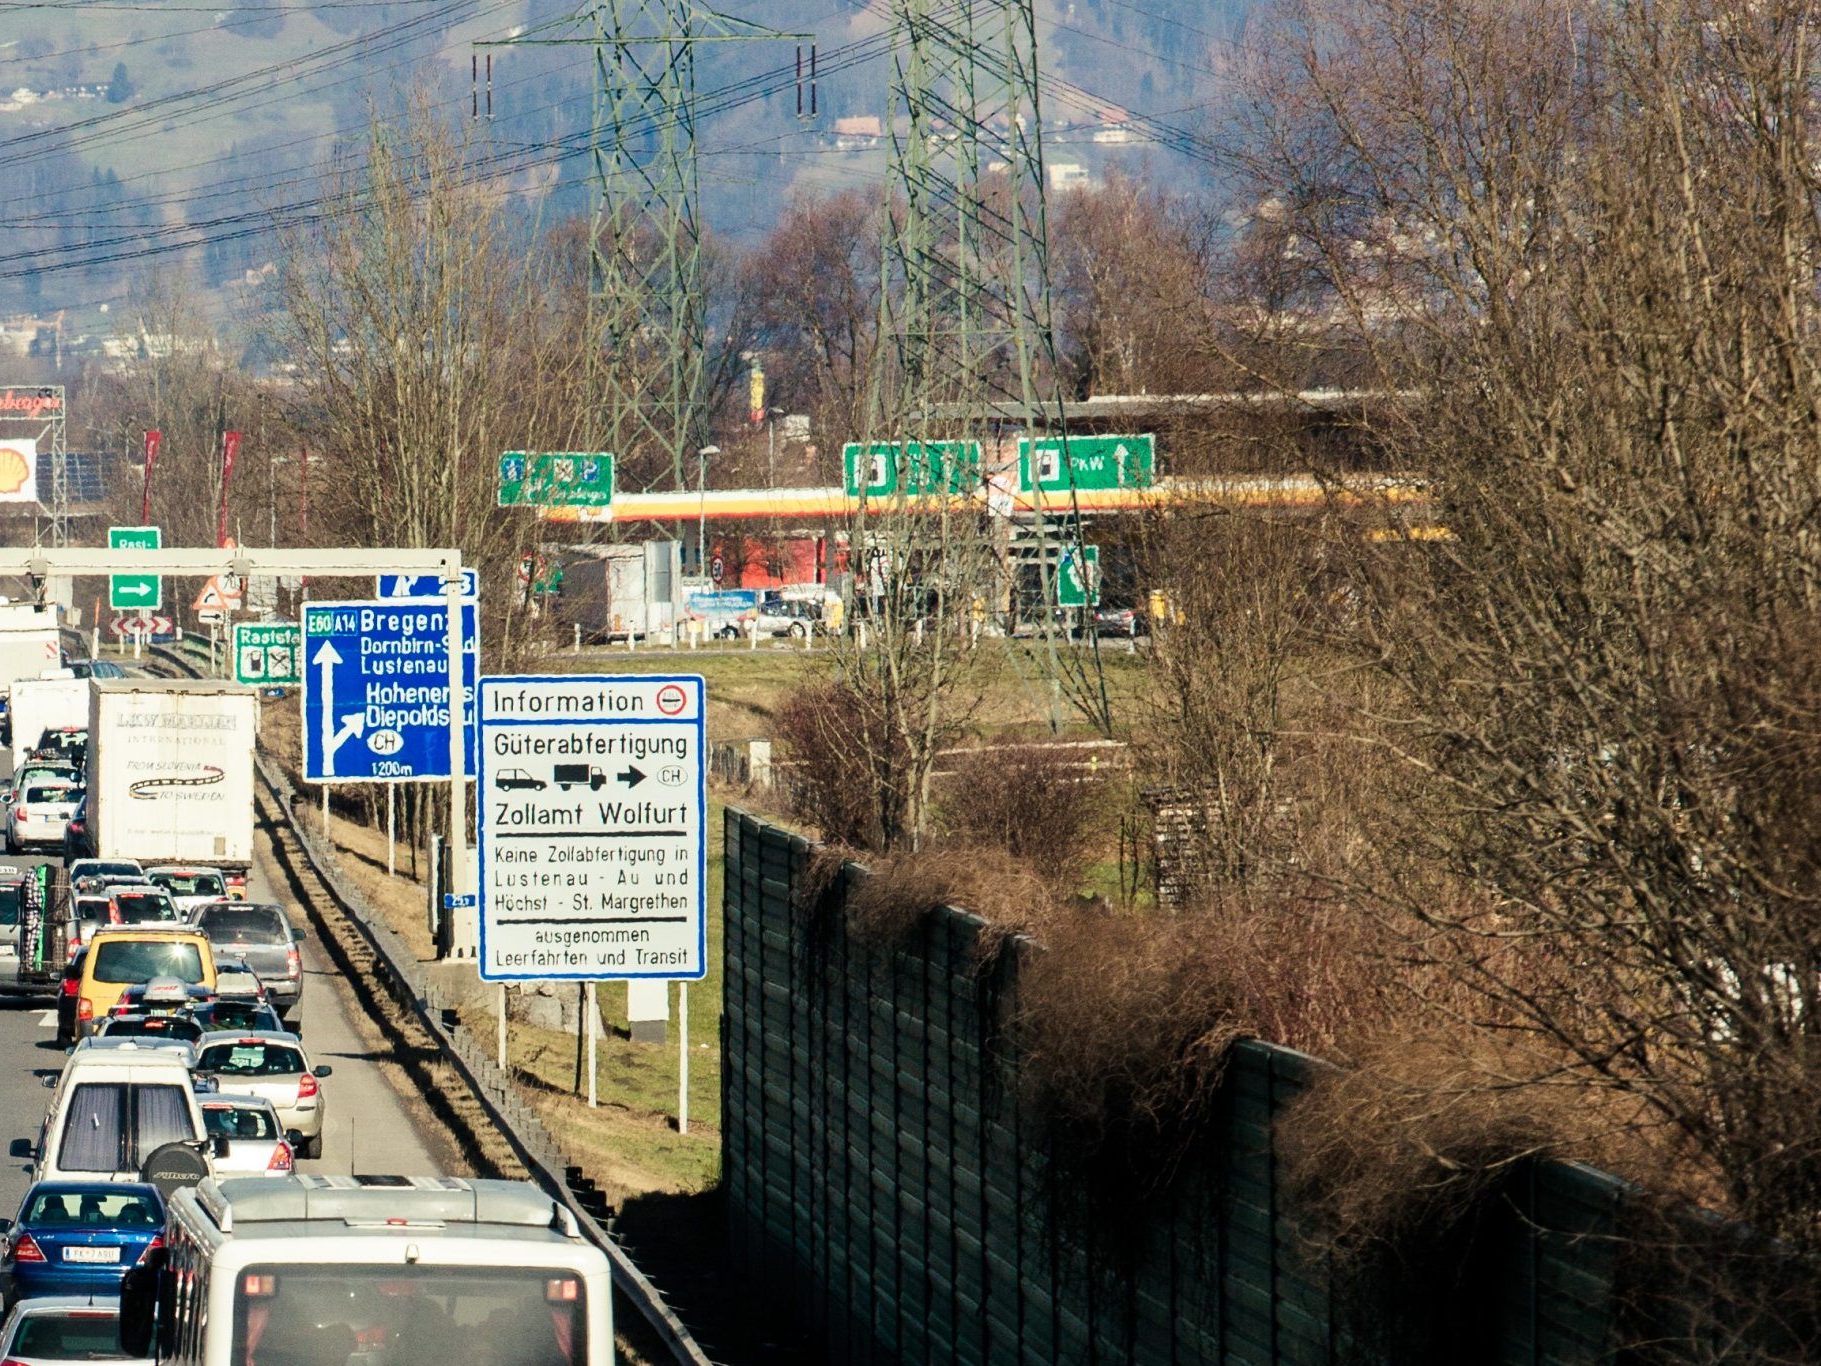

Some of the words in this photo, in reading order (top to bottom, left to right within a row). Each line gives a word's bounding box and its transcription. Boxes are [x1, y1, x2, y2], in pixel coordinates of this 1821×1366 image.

[307, 615, 331, 633] E60
[334, 614, 356, 632] A14
[360, 609, 449, 636] Bregen
[360, 635, 475, 655] Dornbirn-Sd
[360, 655, 448, 675] Lustenau
[493, 689, 644, 713] Information
[366, 704, 473, 732] Diepoldsu
[373, 733, 395, 751] CH
[493, 732, 688, 759] Güterabfertigung
[661, 769, 681, 783] CH
[495, 802, 584, 825] Zollamt
[598, 802, 687, 824] Wolfurt
[495, 846, 538, 863] Keine
[547, 845, 666, 866] Zollabfertigung
[674, 844, 688, 862] in
[495, 870, 588, 887] Lustenau
[617, 868, 640, 885] Au
[655, 868, 688, 885] und
[495, 893, 548, 912] Höchst
[572, 893, 593, 911] St.
[601, 891, 688, 914] Margrethen
[535, 928, 650, 947] ausgenommen
[495, 948, 588, 966] Leerfahrten
[596, 949, 626, 965] und
[635, 947, 688, 965] Transit
